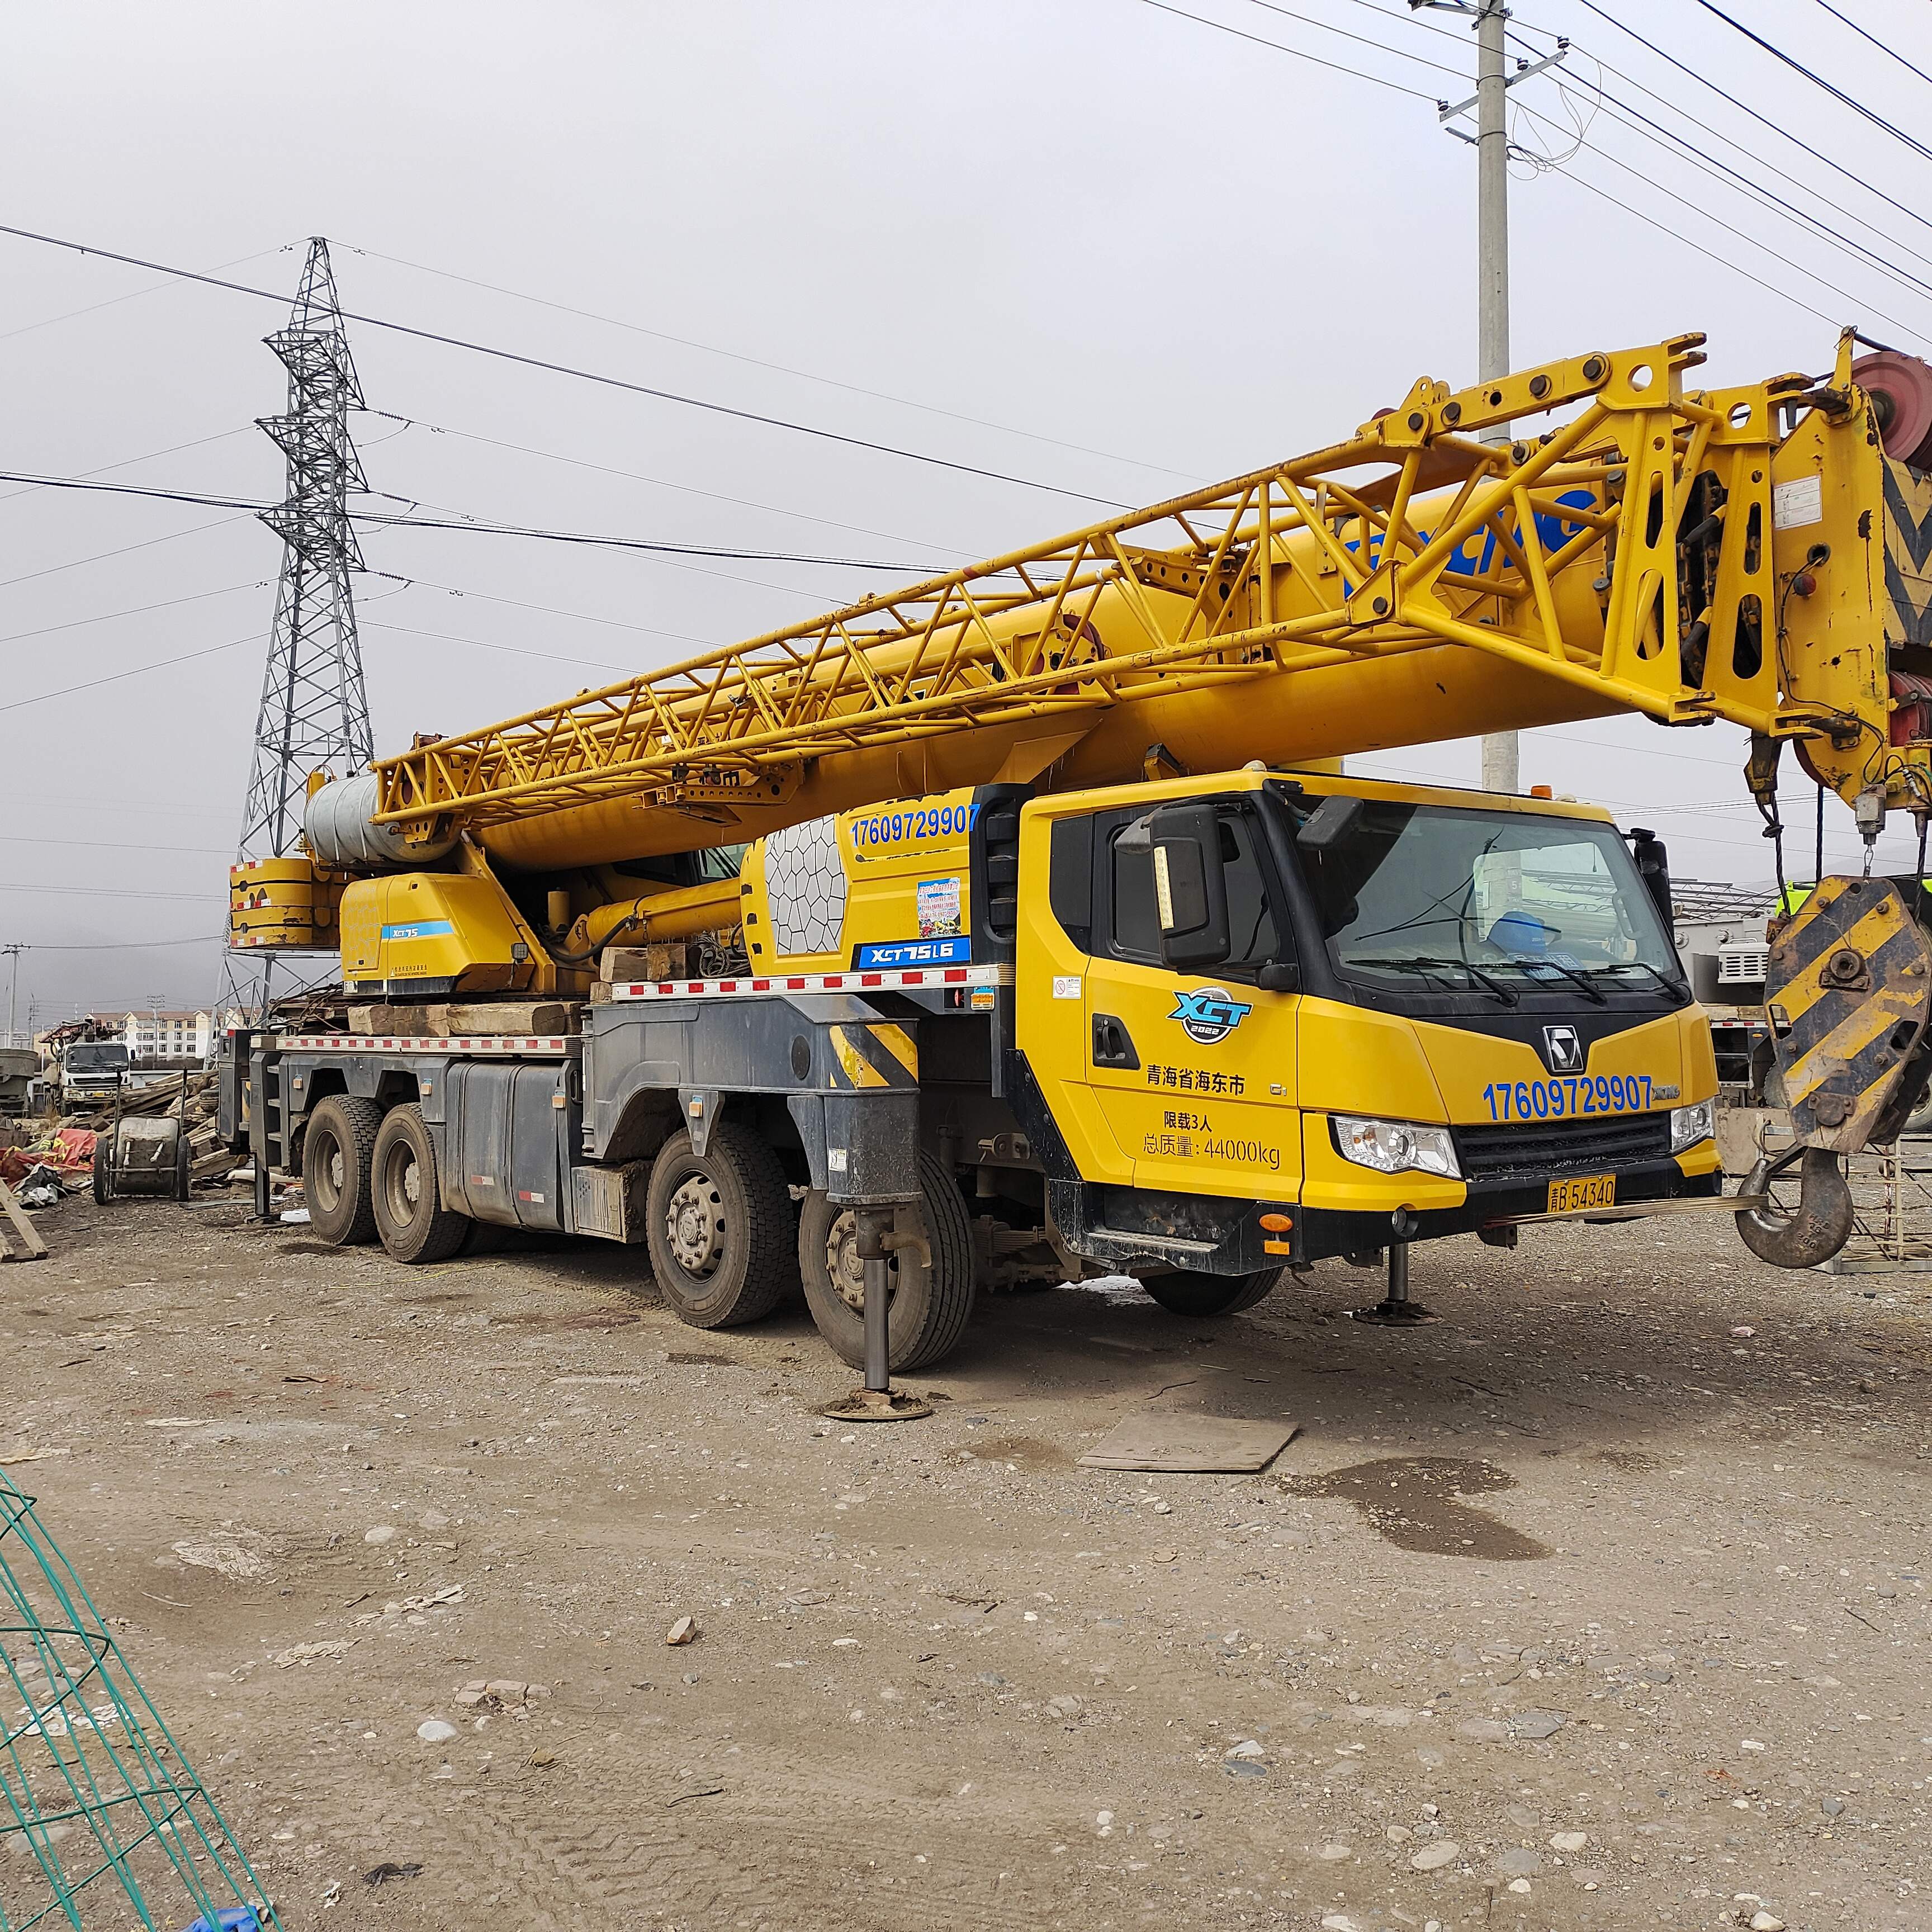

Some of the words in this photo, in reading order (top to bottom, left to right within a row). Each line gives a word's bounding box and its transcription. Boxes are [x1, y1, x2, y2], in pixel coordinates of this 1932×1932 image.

[850, 803, 981, 846] 17609729907
[392, 927, 418, 938] XCT75
[870, 943, 954, 963] XCT75L6
[1168, 992, 1253, 1027] XCT
[1191, 1025, 1220, 1035] 2022
[1147, 1064, 1246, 1096] 青海省海东市
[1483, 1075, 1651, 1120] 17609729907
[1163, 1110, 1213, 1133] 限载3人
